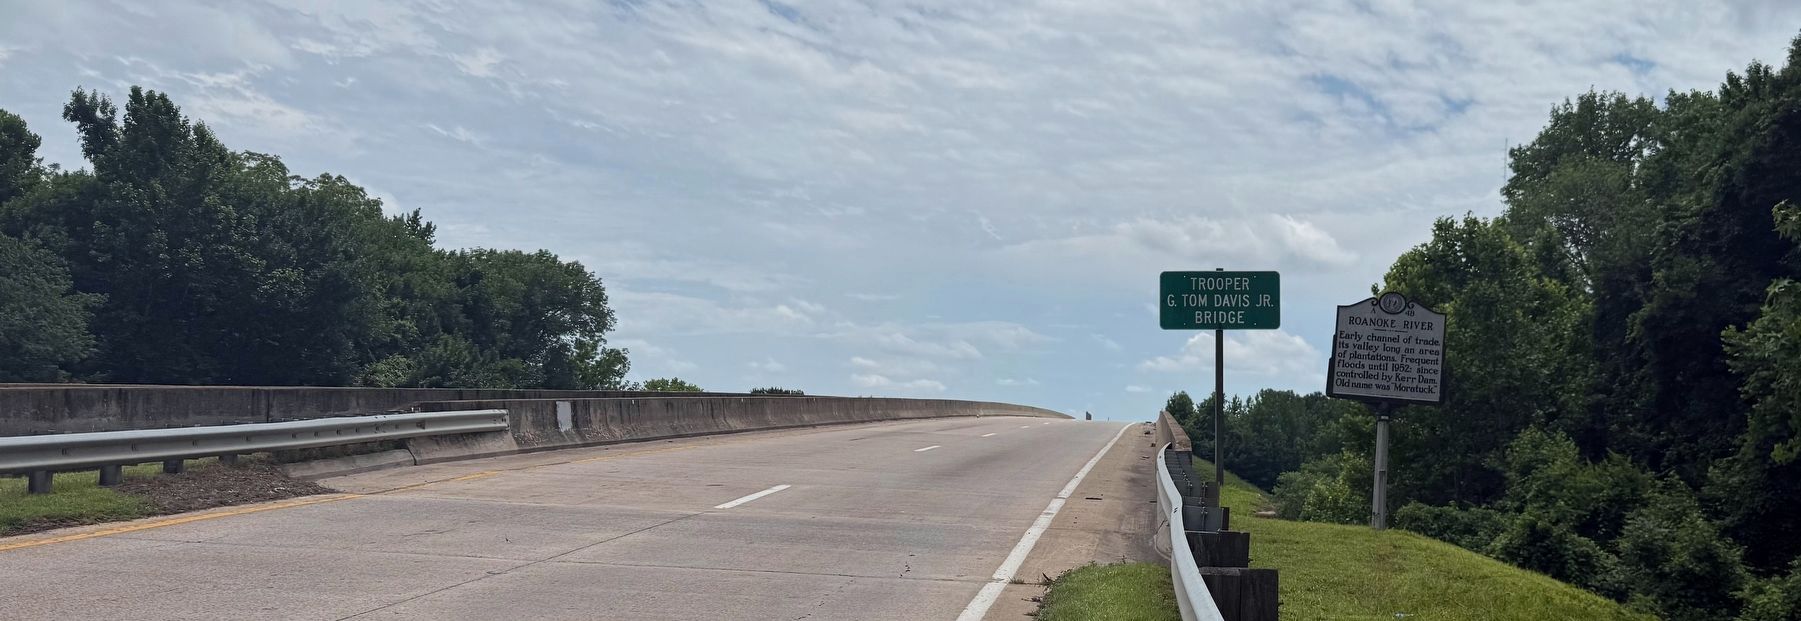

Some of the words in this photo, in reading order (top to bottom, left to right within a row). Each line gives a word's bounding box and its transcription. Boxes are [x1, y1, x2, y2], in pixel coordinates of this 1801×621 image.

[1191, 278, 1250, 290] TROOPER
[1167, 295, 1177, 307] G.
[1182, 295, 1207, 307] TOM
[1215, 295, 1250, 307] DAVIS
[1256, 295, 1274, 307] JR.
[1195, 311, 1244, 323] BRIDGE
[1349, 316, 1396, 328] ROANOKE
[1403, 321, 1433, 331] RIVER
[1340, 331, 1363, 341] Early
[1367, 334, 1399, 344] channel
[1403, 336, 1413, 344] of
[1353, 342, 1379, 353] valley
[1383, 344, 1400, 354] long
[1338, 350, 1346, 358] of
[1349, 352, 1397, 362] plantations.
[1401, 355, 1439, 366] Frequent
[1338, 359, 1365, 369] floods
[1369, 363, 1388, 371] until
[1335, 379, 1349, 387] Old
[1336, 371, 1379, 380] controlled
[1382, 373, 1393, 382] by
[1395, 373, 1416, 383] Kerr
[1418, 376, 1437, 384] Dam.
